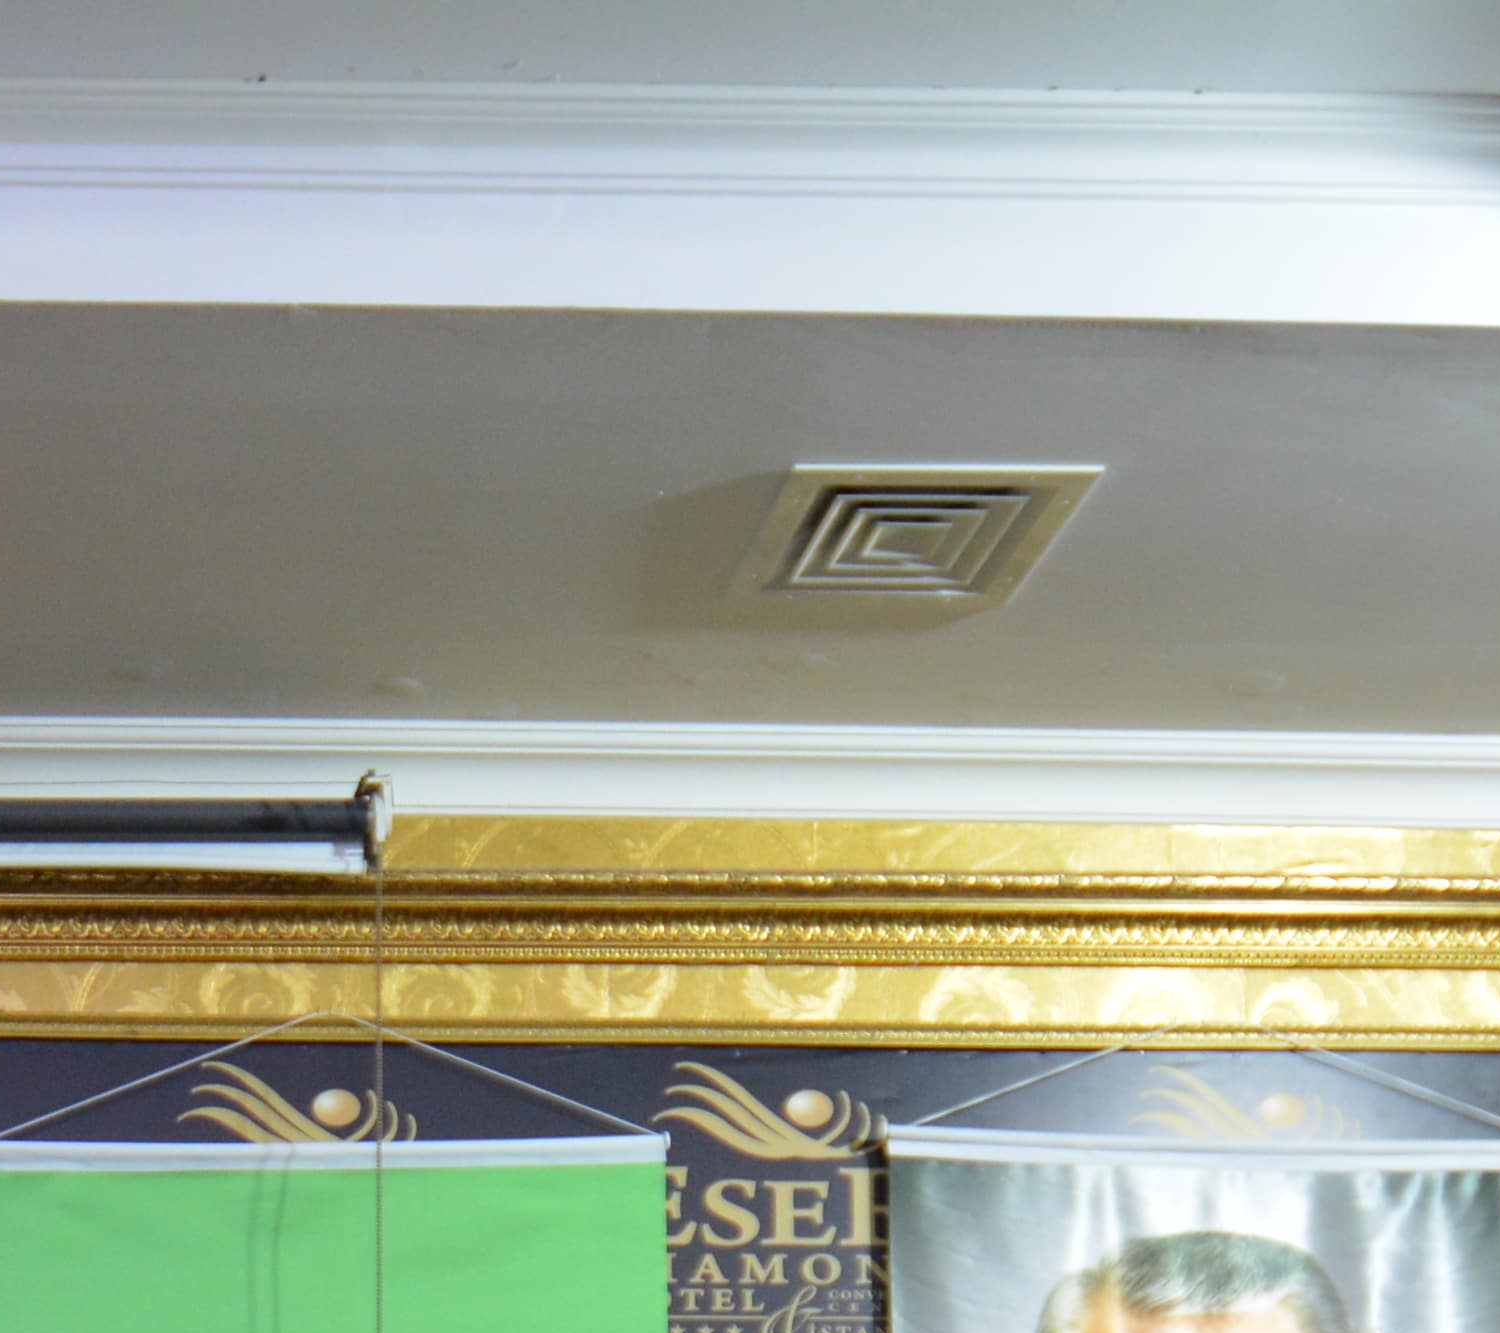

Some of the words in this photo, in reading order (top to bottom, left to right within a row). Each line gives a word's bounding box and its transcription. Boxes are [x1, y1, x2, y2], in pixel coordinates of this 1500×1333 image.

[667, 1253, 888, 1285] AMON
[667, 1287, 765, 1312] TEL
[828, 1302, 882, 1312] CEN
